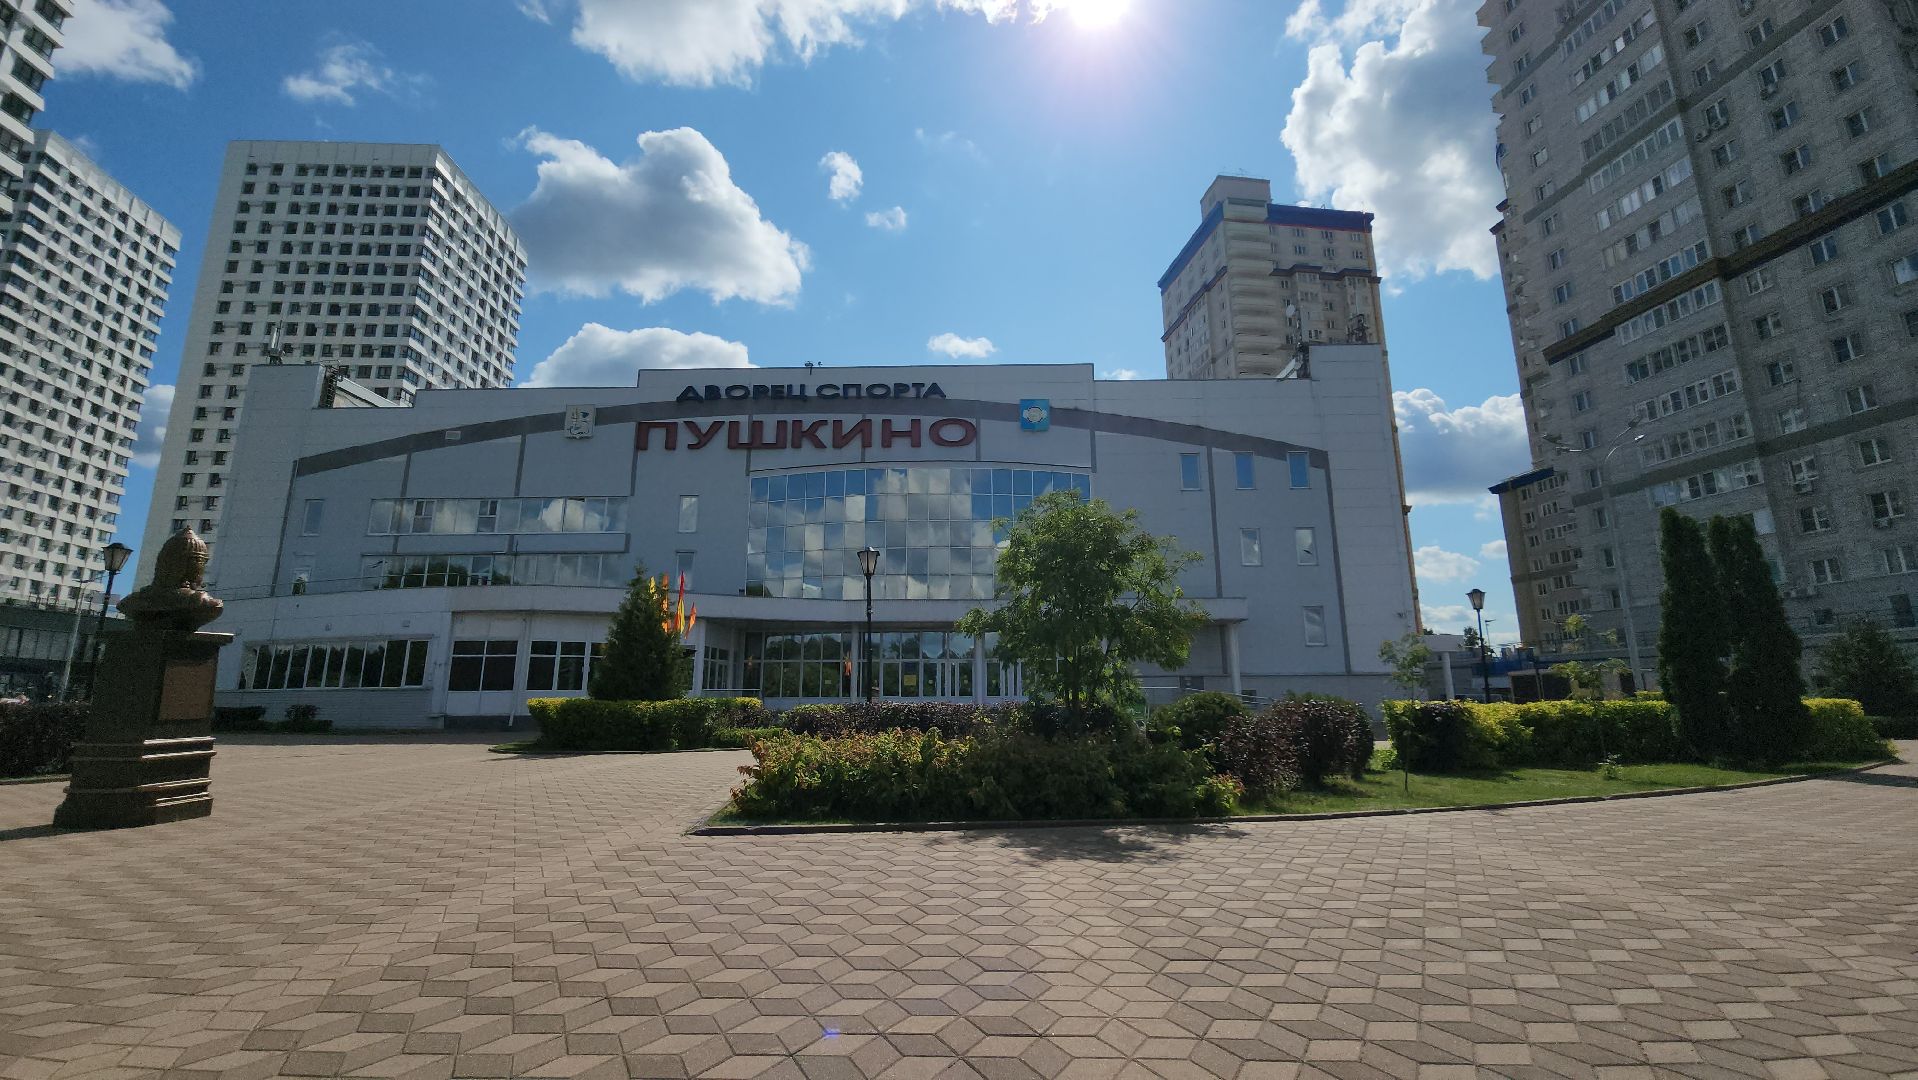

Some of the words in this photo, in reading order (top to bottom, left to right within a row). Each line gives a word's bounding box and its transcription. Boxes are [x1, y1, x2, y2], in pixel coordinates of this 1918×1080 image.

[676, 383, 808, 403] ДВОРЕЦ
[816, 382, 947, 400] СПОРТА
[636, 418, 978, 450] ПУШКИНО
